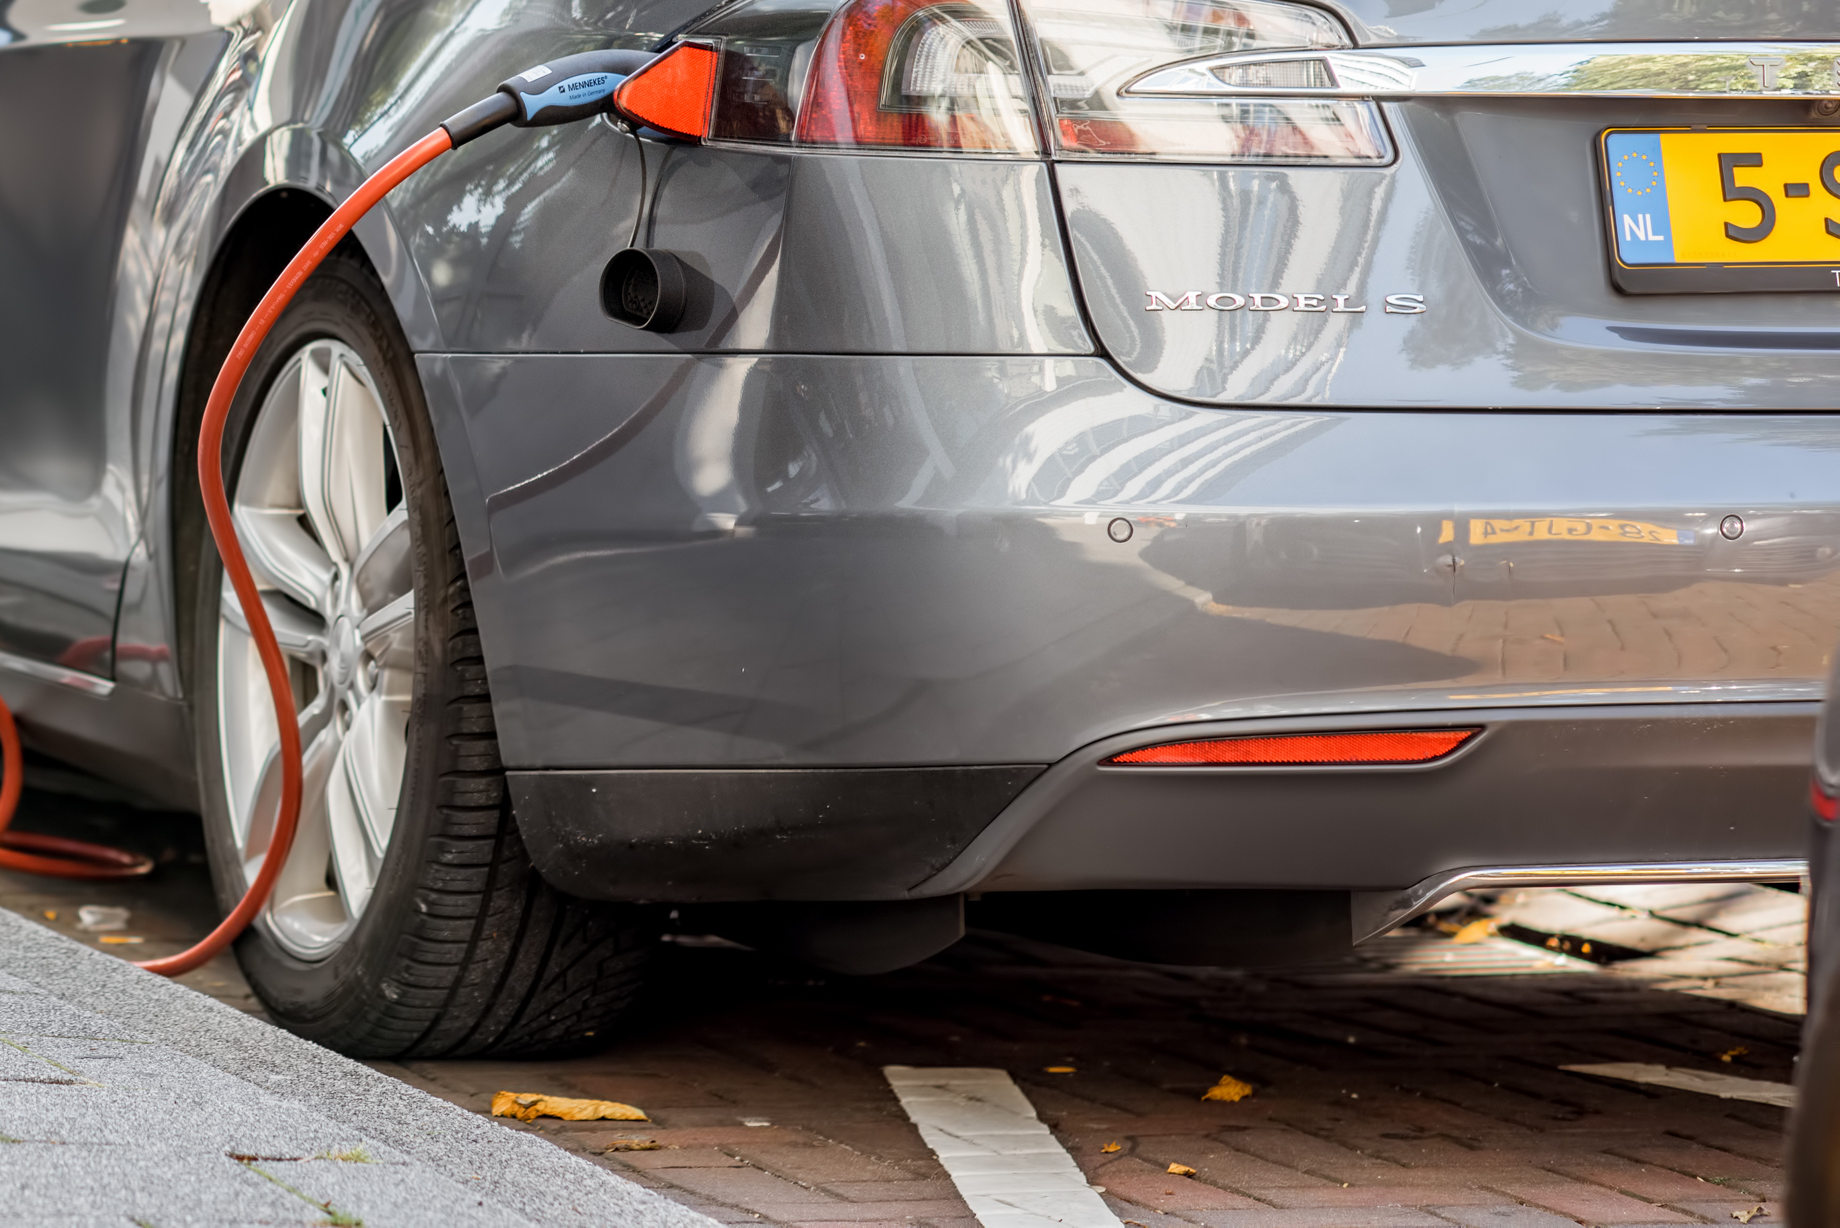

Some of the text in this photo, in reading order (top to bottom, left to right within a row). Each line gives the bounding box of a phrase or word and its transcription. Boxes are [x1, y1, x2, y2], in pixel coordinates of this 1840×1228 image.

[587, 88, 606, 97] Germany
[1623, 213, 1664, 241] NL
[1144, 290, 1427, 315] MODEL S
